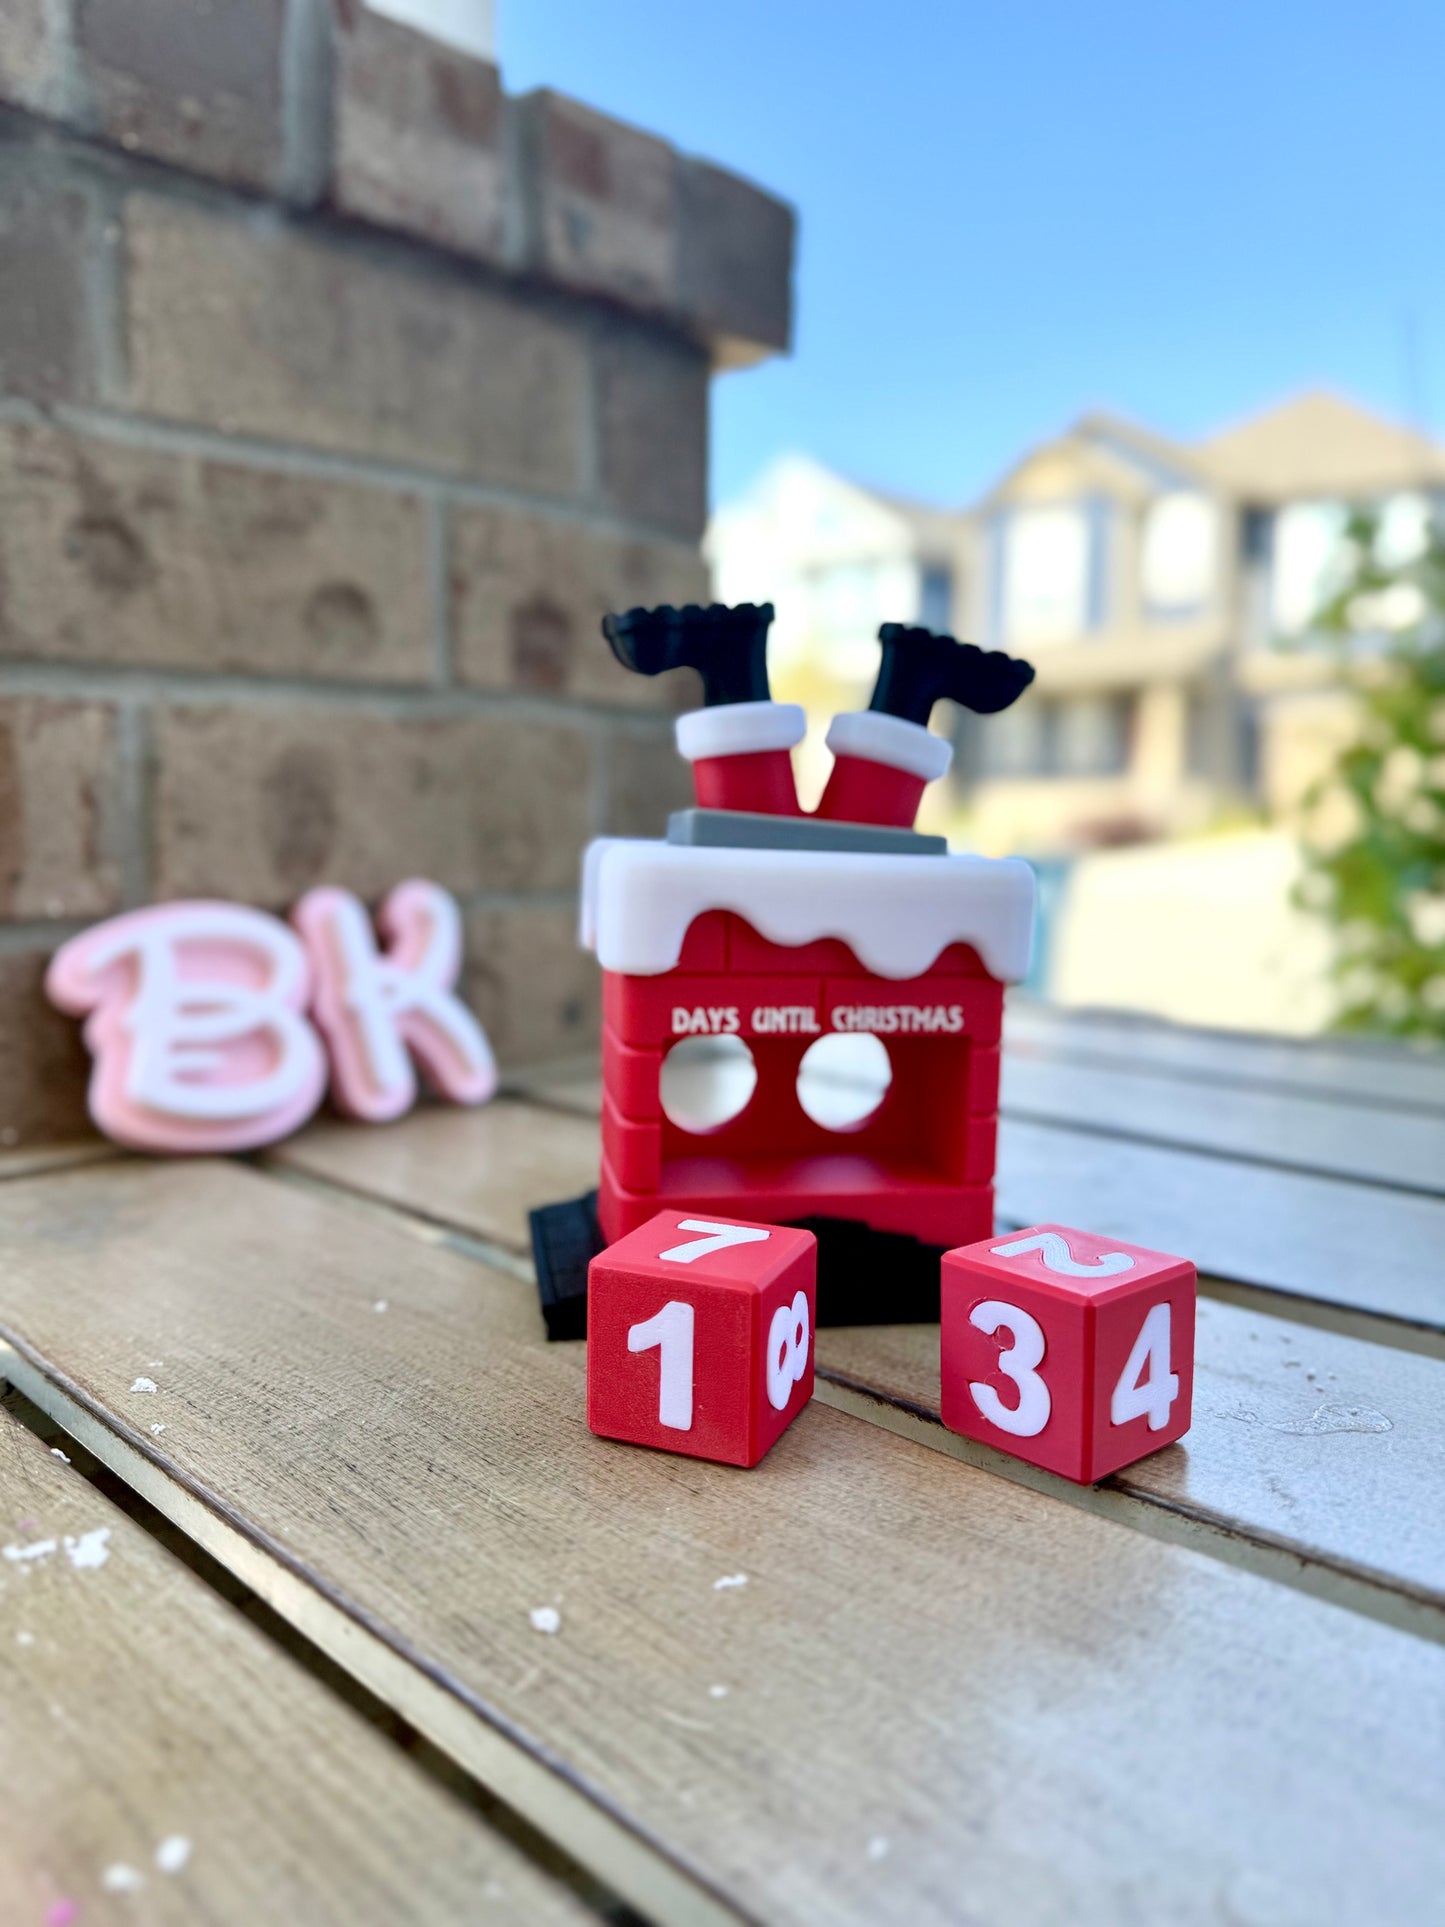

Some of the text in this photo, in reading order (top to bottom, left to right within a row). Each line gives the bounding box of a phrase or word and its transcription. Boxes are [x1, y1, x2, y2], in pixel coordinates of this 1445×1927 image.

[671, 1005, 964, 1034] DAYS UNTIL CHRISTMAS
[659, 1219, 770, 1263] 7
[627, 1300, 694, 1431] 1
[767, 1290, 809, 1411] 8
[969, 1300, 1051, 1437] 3
[1111, 1302, 1179, 1432] 4
